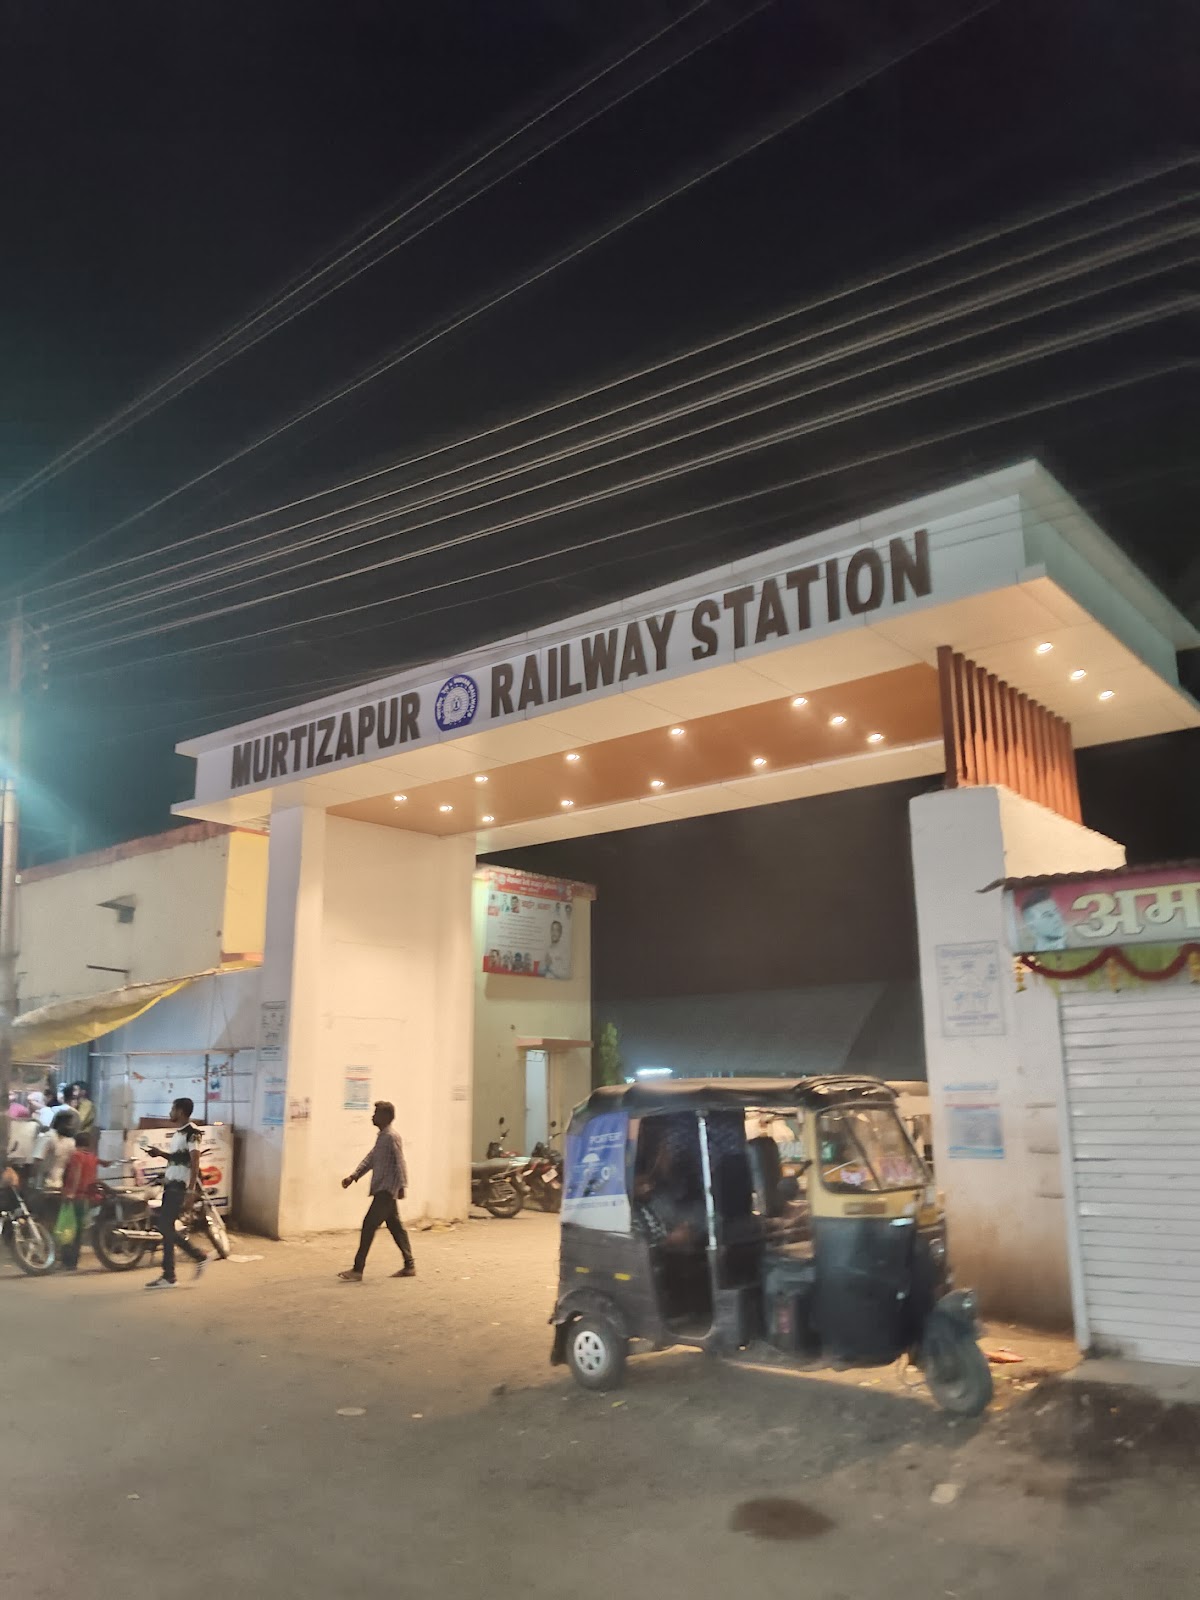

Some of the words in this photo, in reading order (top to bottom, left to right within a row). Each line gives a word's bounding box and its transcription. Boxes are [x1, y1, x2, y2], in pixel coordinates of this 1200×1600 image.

[230, 692, 421, 790] MURTIZAPUR
[490, 610, 676, 719] RAILWAY
[691, 528, 932, 661] STATION
